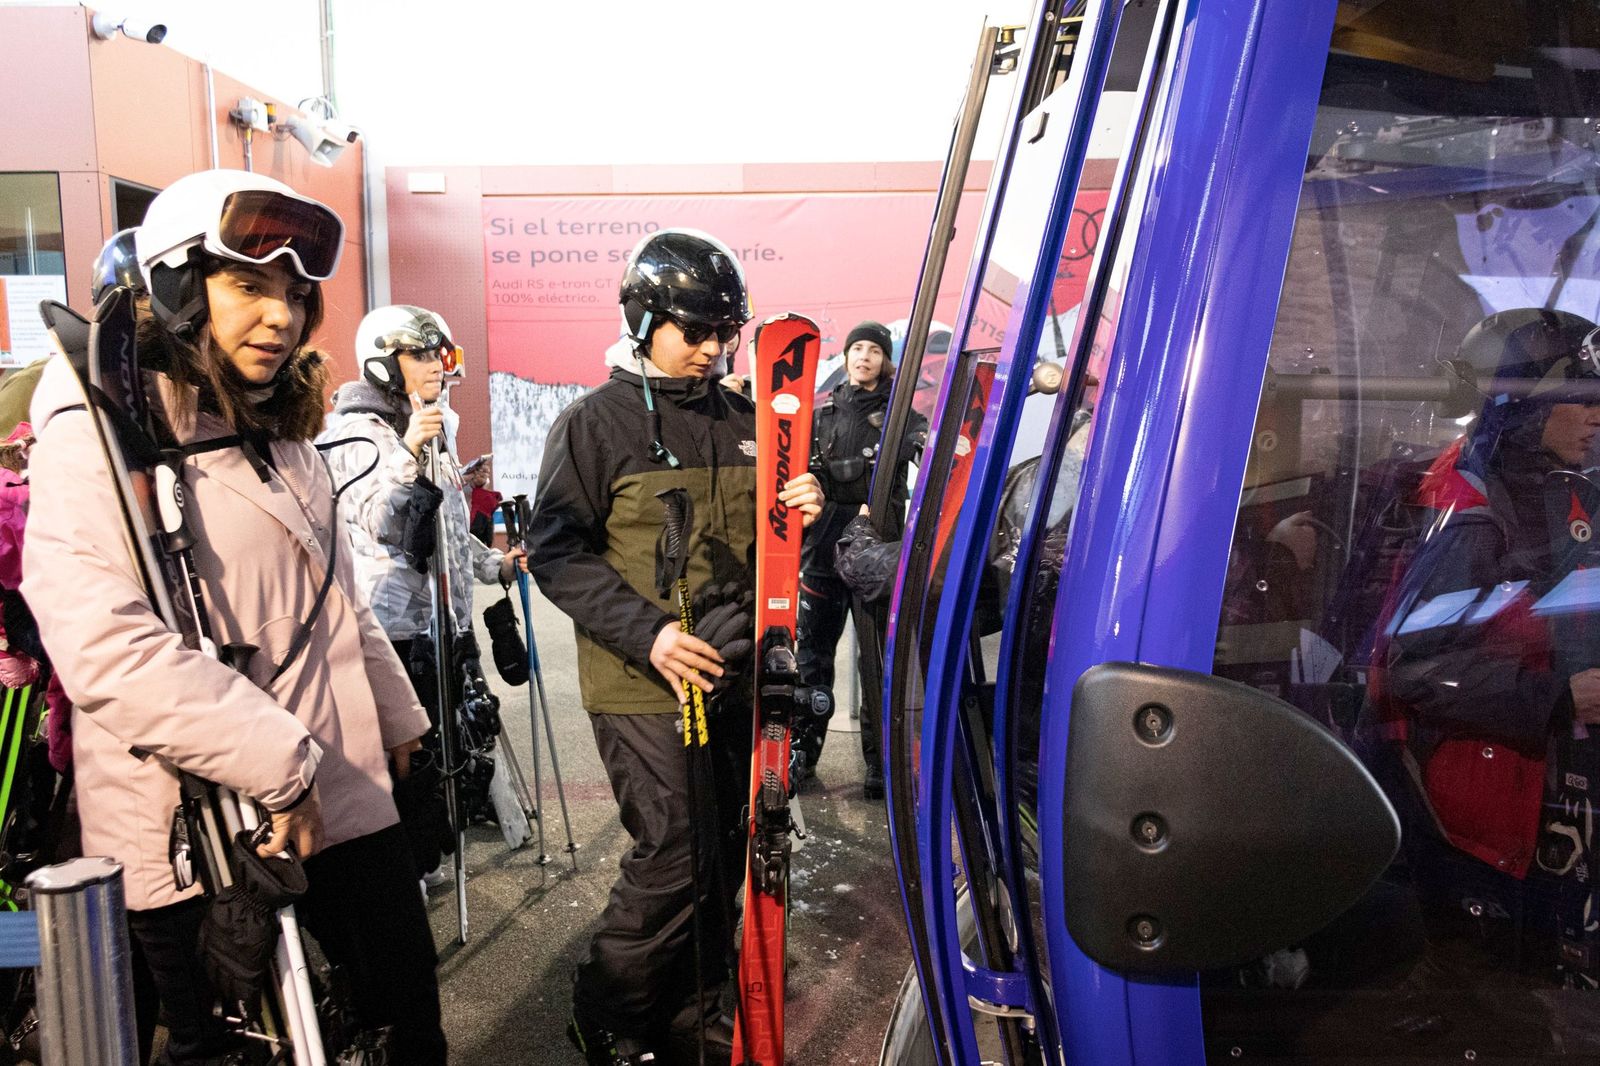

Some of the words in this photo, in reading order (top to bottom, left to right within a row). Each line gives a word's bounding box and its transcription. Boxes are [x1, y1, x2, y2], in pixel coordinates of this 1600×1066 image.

[491, 218, 515, 236] Si
[524, 218, 548, 236] el
[556, 219, 660, 236] terreno
[491, 249, 524, 264] se
[530, 249, 598, 269] pone
[491, 279, 523, 290] Audi
[527, 279, 545, 290] RS
[548, 280, 591, 290] e-tron
[594, 279, 615, 290] GT
[494, 293, 535, 304] 100%
[537, 291, 600, 304] eléctrico.
[501, 472, 528, 480] Audi,
